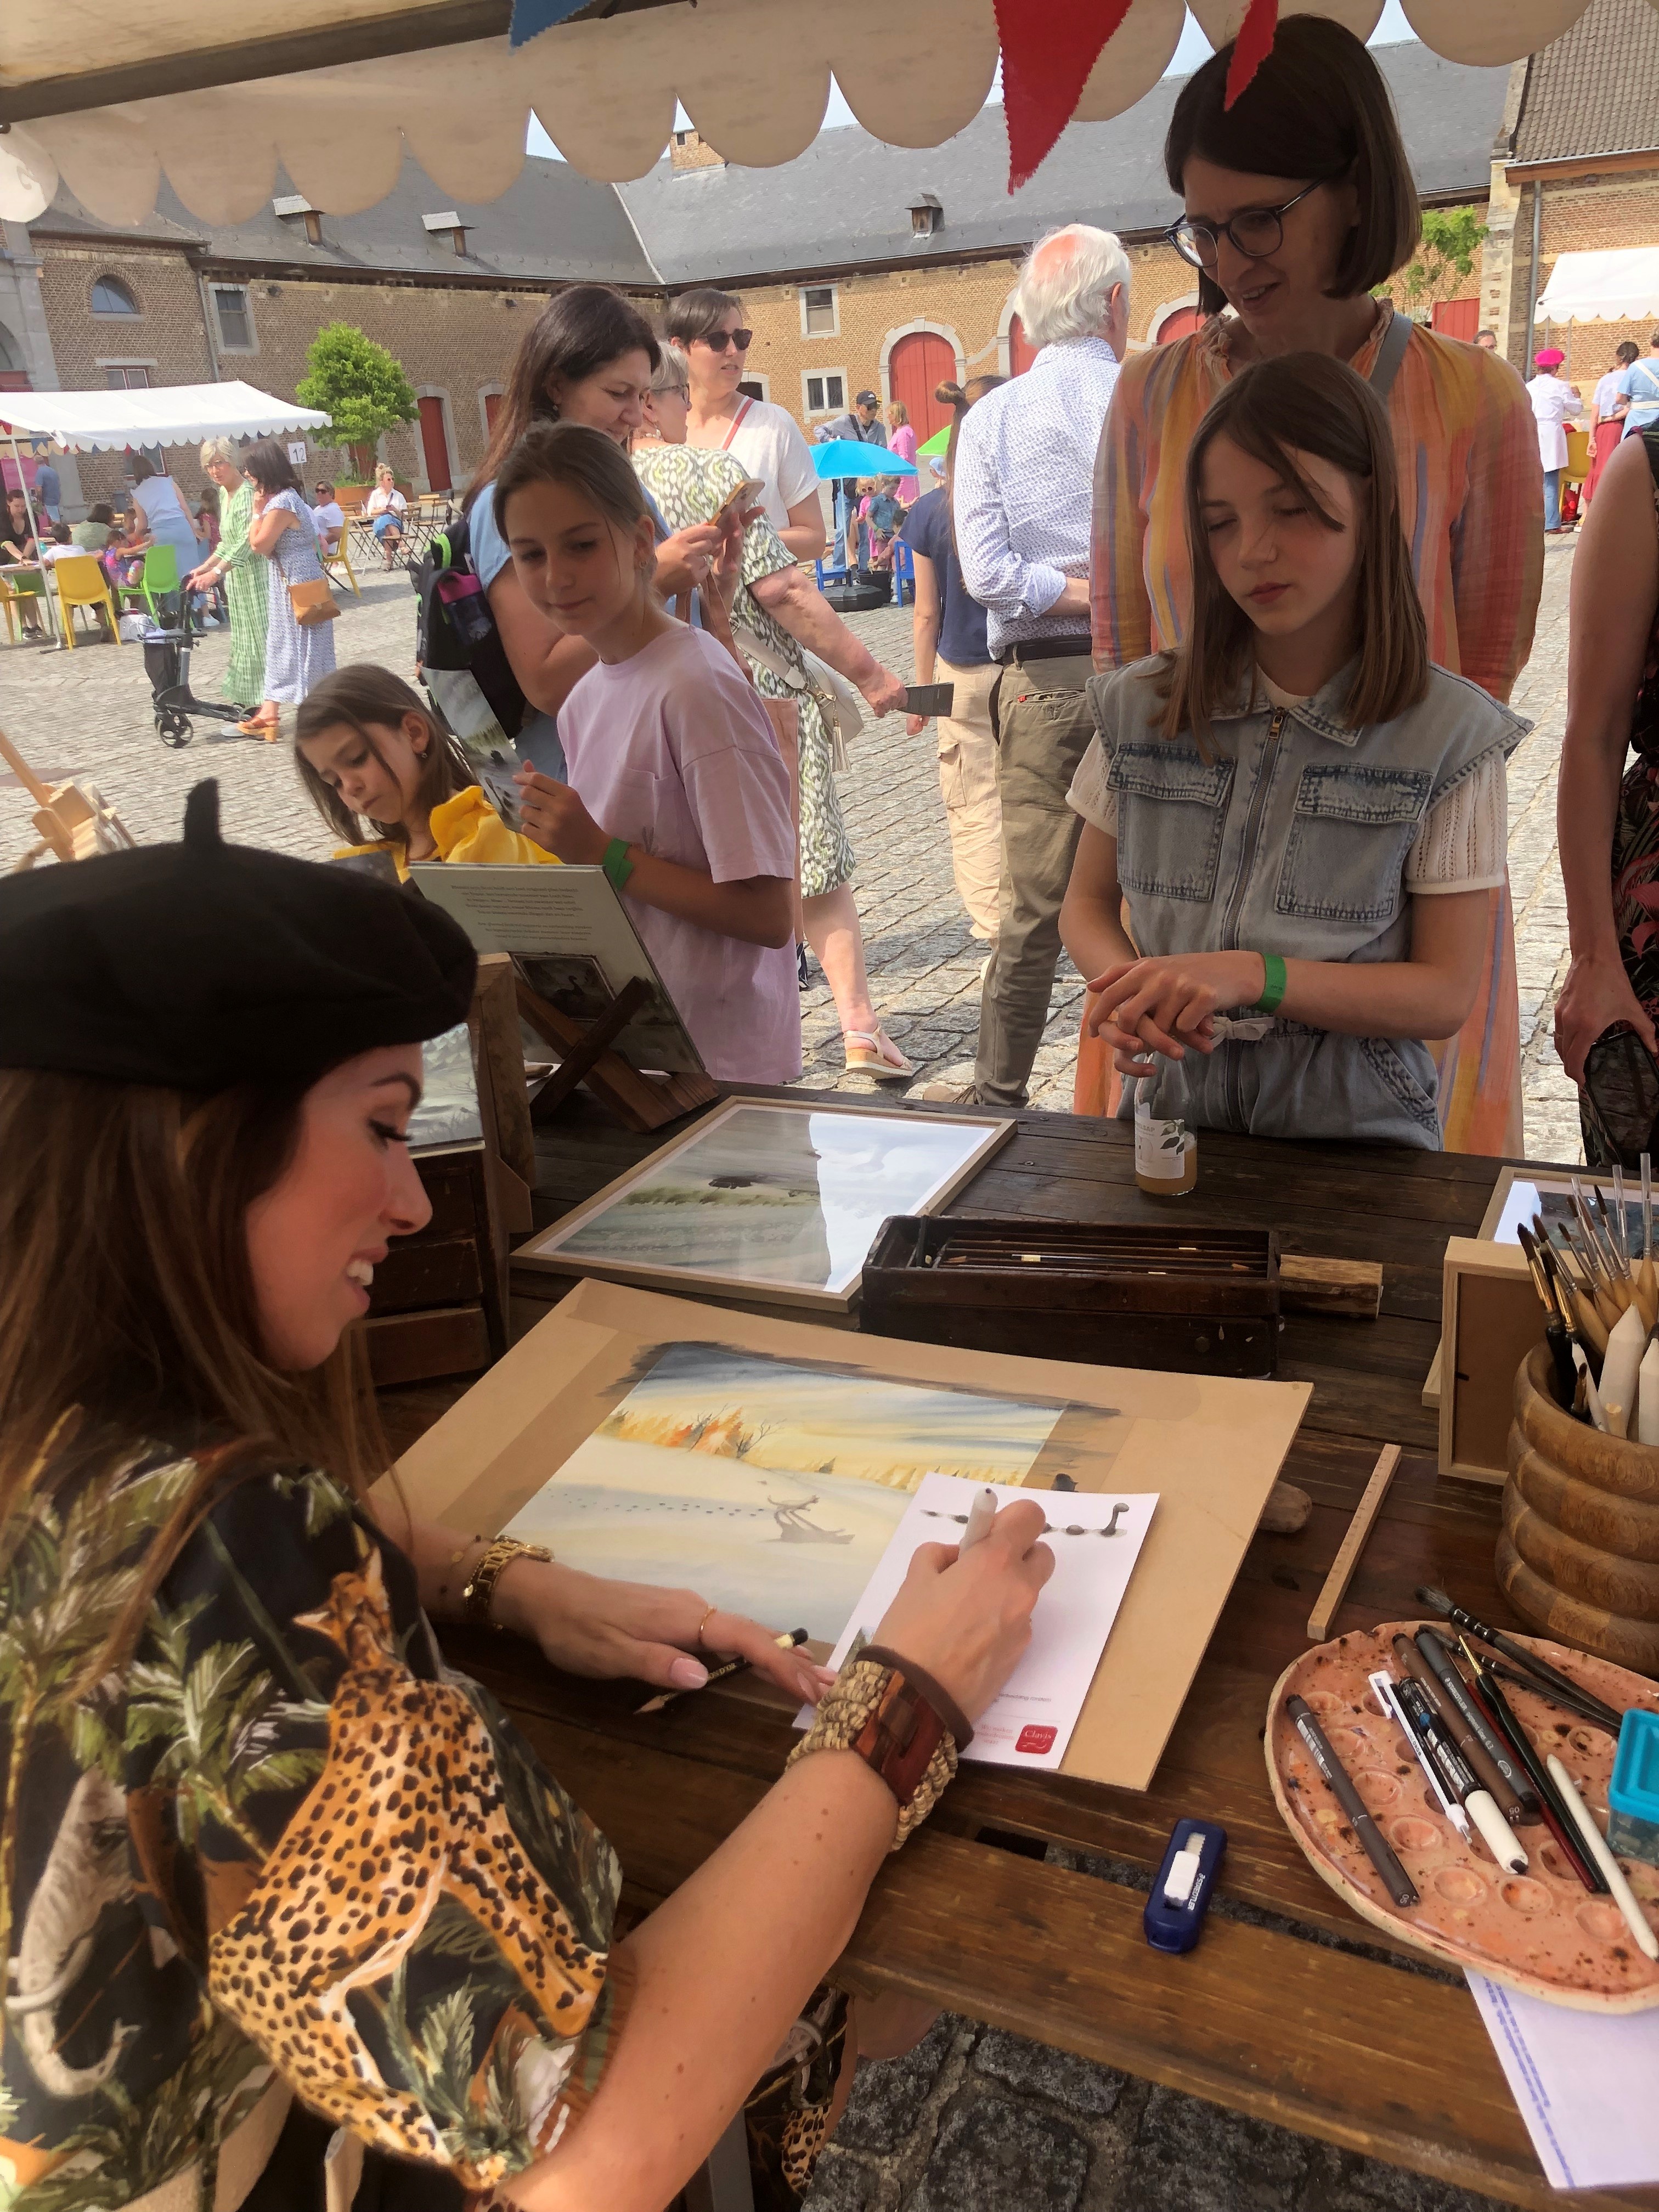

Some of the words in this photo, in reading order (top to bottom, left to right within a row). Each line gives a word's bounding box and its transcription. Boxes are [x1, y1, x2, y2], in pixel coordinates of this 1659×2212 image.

[292, 447, 305, 462] 12
[1447, 1681, 1468, 1711] STAEDTLER
[1025, 1729, 1052, 1740] Clavis
[1187, 1877, 1204, 1911] STAEDTLER
